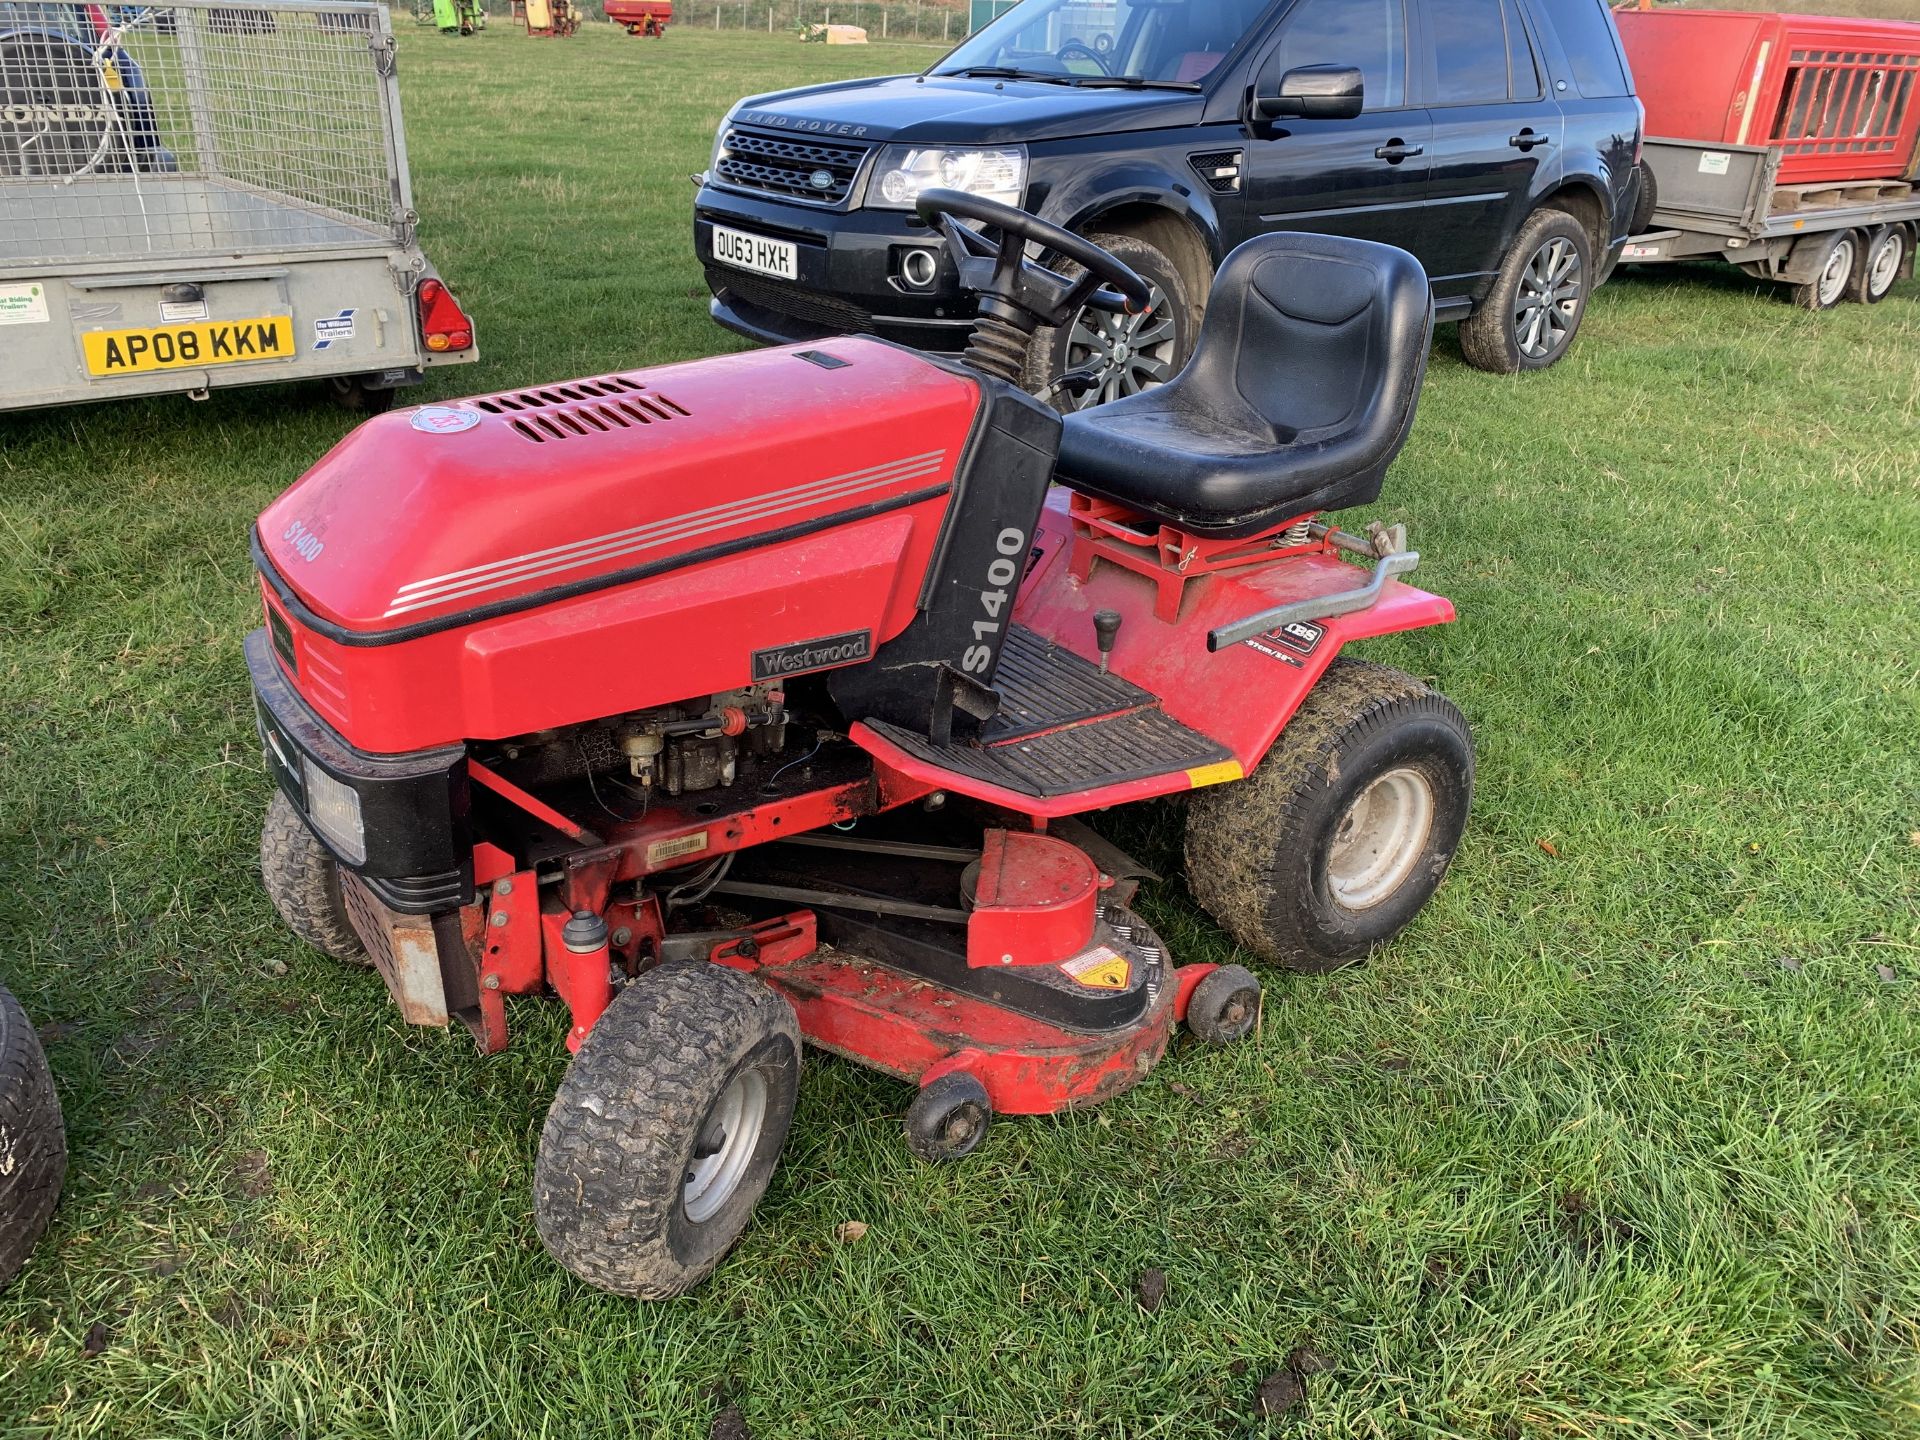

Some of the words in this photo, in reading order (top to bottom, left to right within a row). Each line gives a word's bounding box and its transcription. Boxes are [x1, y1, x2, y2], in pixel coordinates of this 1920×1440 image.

[0, 105, 124, 123] ONDA
[745, 113, 788, 126] LAND
[794, 119, 867, 136] ROVER
[718, 232, 753, 263] OU63
[106, 331, 199, 368] AP08
[209, 323, 279, 357] KKM
[283, 520, 324, 562] S1400
[962, 528, 1025, 674] S1400
[759, 635, 866, 674] Westwood
